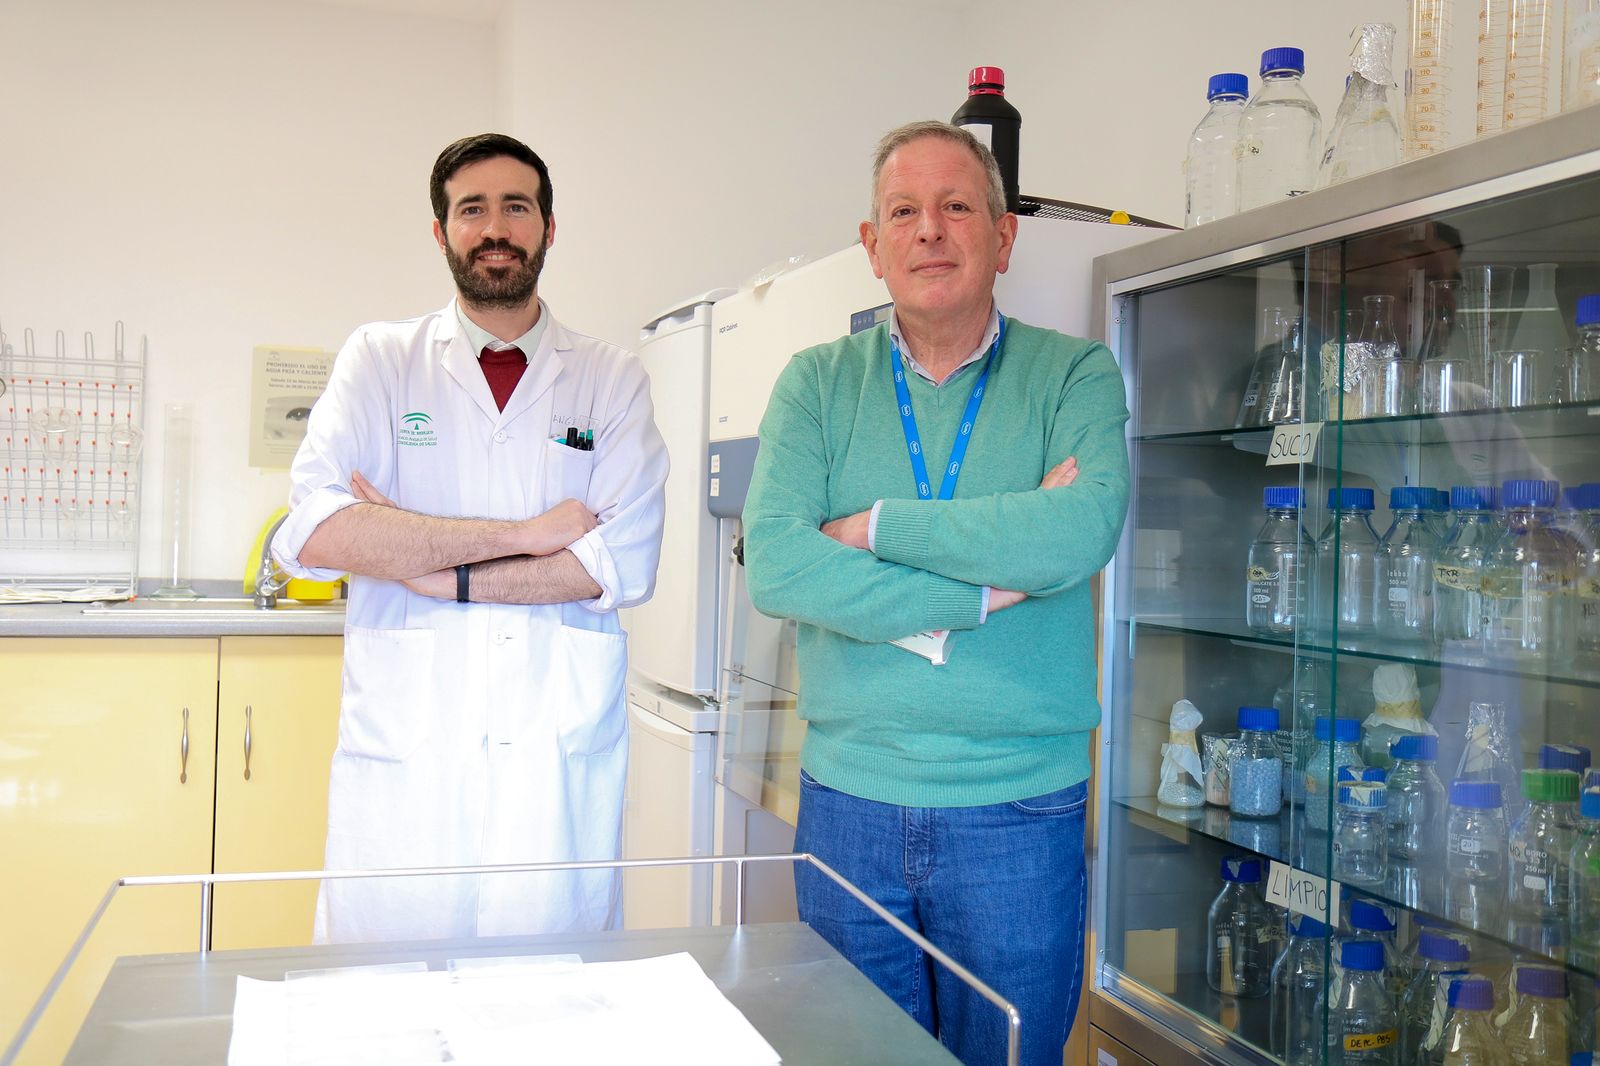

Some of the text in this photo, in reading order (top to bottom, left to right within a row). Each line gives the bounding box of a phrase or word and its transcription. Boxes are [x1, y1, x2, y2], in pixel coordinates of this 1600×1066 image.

[1271, 433, 1310, 458] SUCO
[1525, 849, 1547, 859] BORO
[1525, 864, 1537, 873] 250
[1272, 869, 1328, 911] LIMPIO
